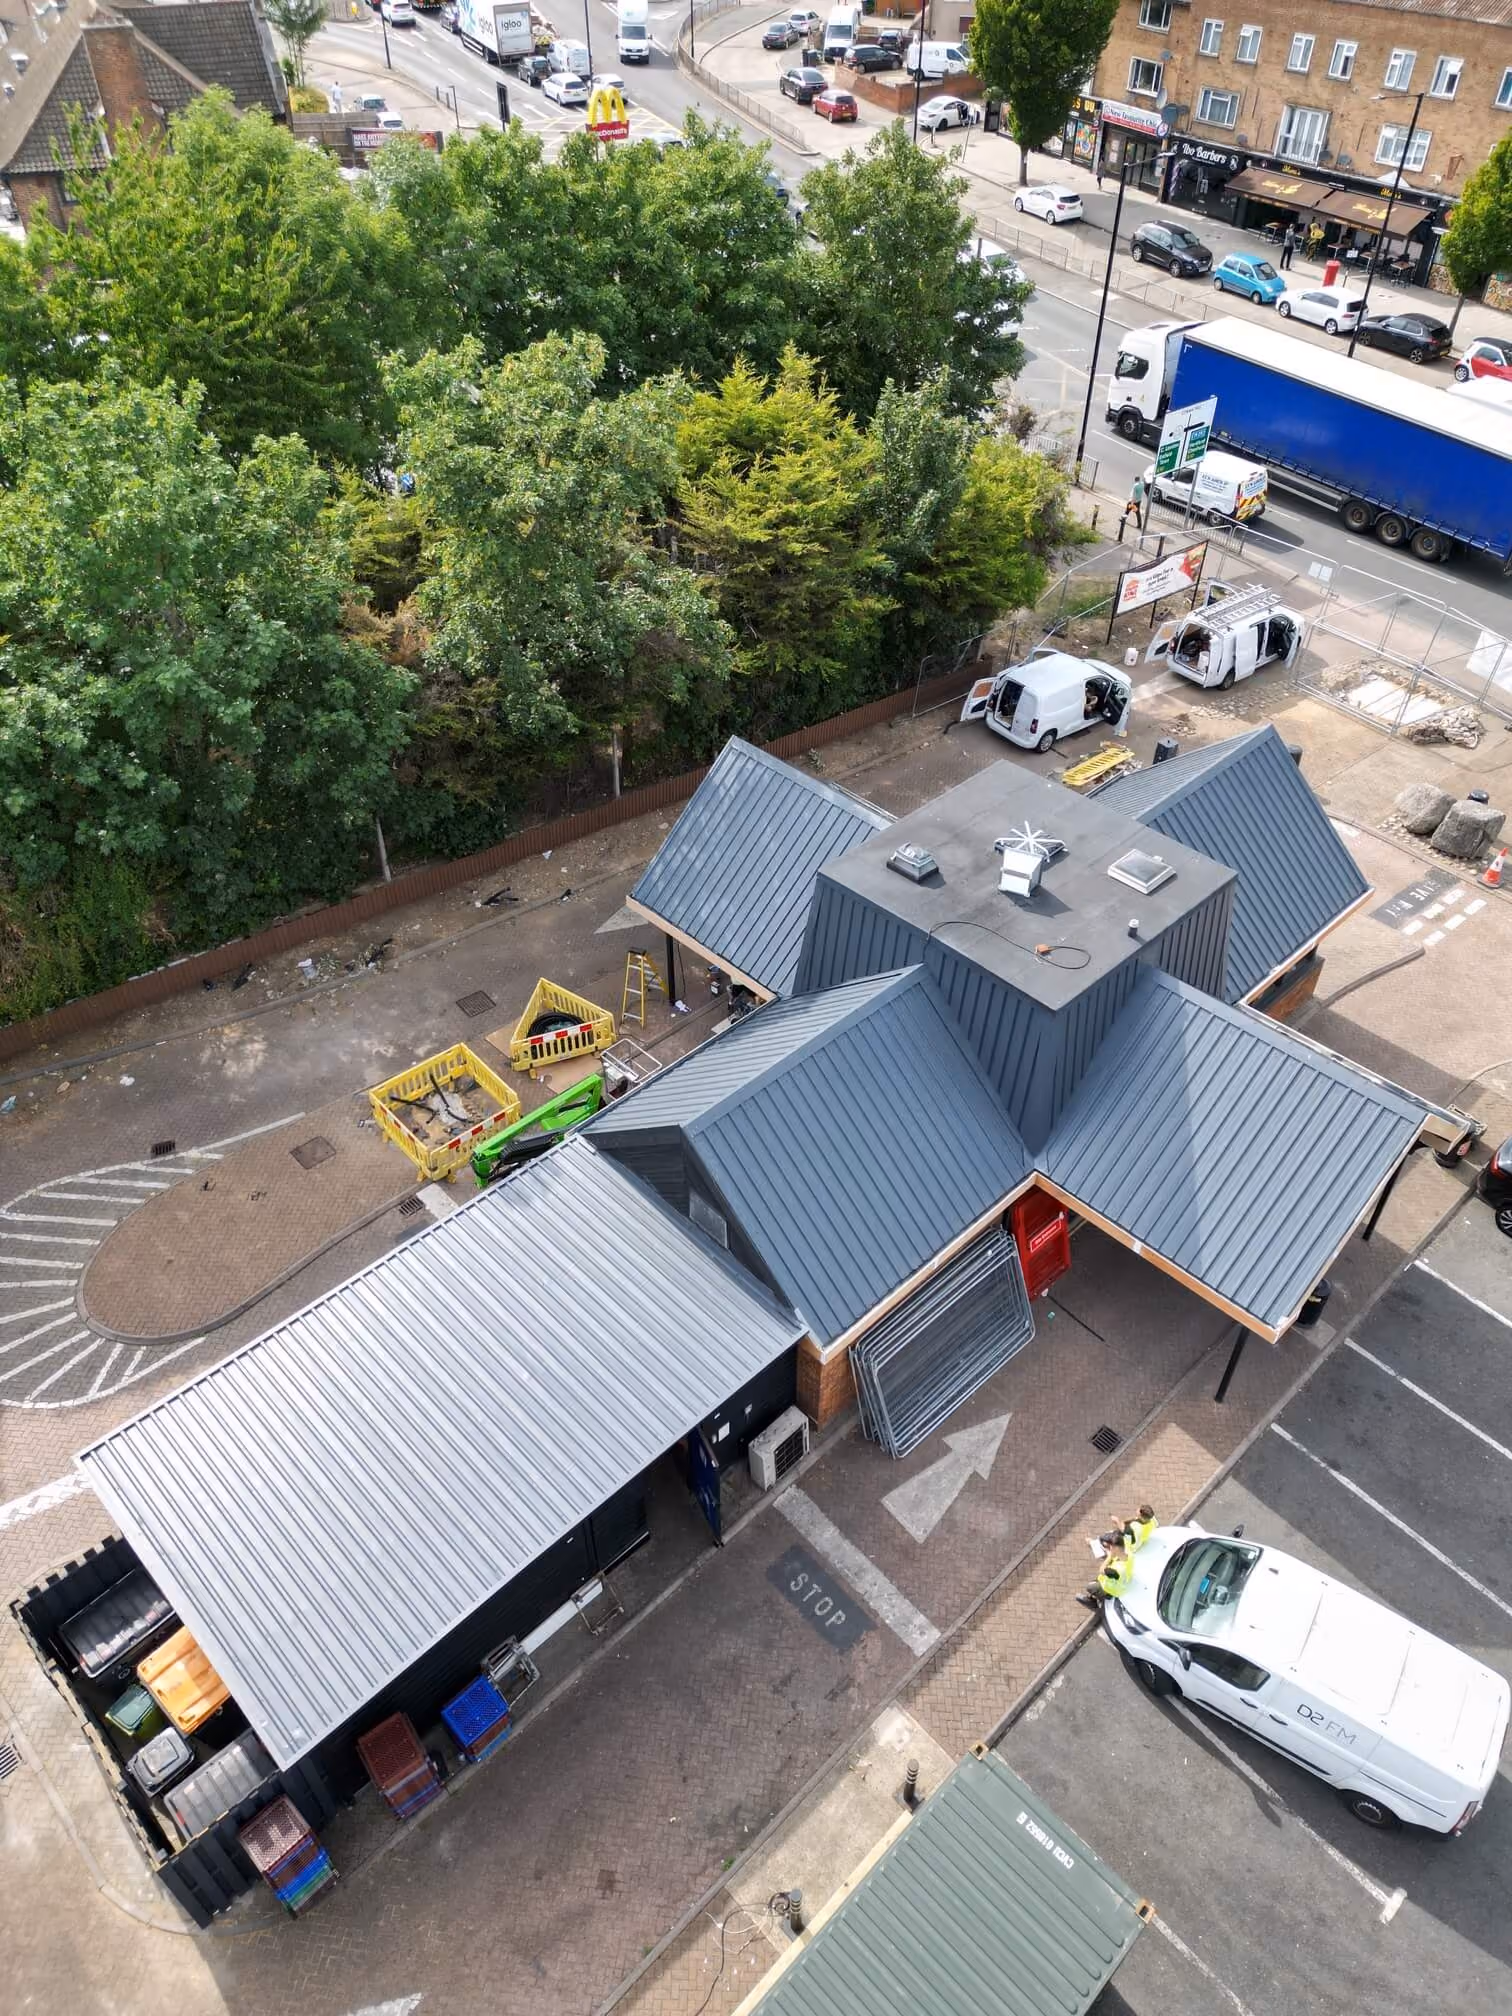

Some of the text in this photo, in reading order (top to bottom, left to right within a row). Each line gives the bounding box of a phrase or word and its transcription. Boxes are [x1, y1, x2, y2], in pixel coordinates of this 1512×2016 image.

[501, 18, 522, 31] igloo
[1196, 146, 1227, 164] Barbers
[790, 1572, 846, 1627] STOP
[1297, 1704, 1357, 1745] D2 FM
